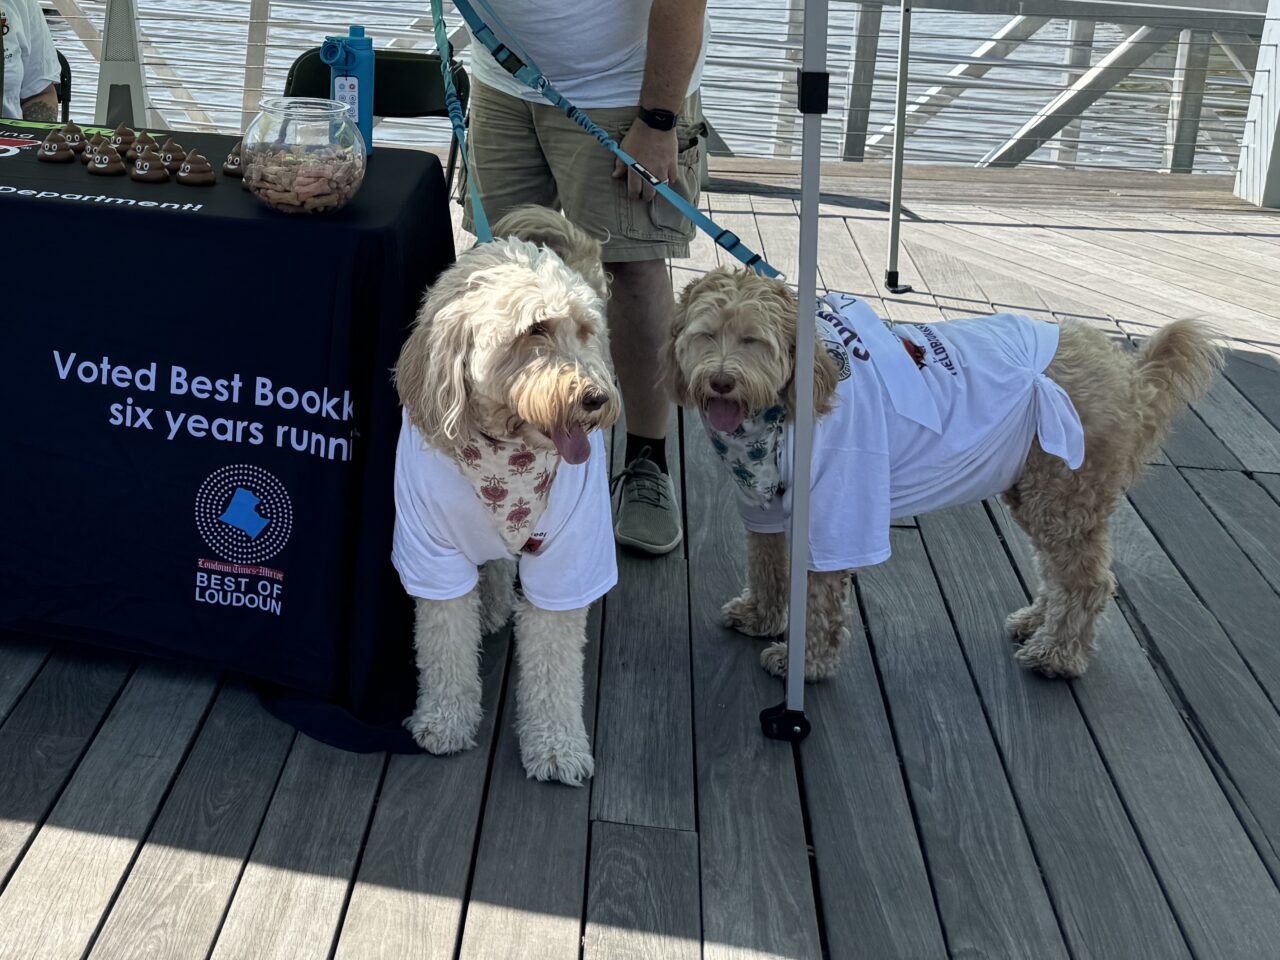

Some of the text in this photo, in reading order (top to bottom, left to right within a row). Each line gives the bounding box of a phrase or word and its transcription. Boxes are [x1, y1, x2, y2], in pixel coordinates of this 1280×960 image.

[53, 350, 157, 391] Voted
[170, 365, 242, 403] Best
[109, 398, 153, 430] six
[166, 410, 264, 445] years
[195, 587, 282, 616] LOUDOUN
[197, 572, 282, 598] BEST OF
